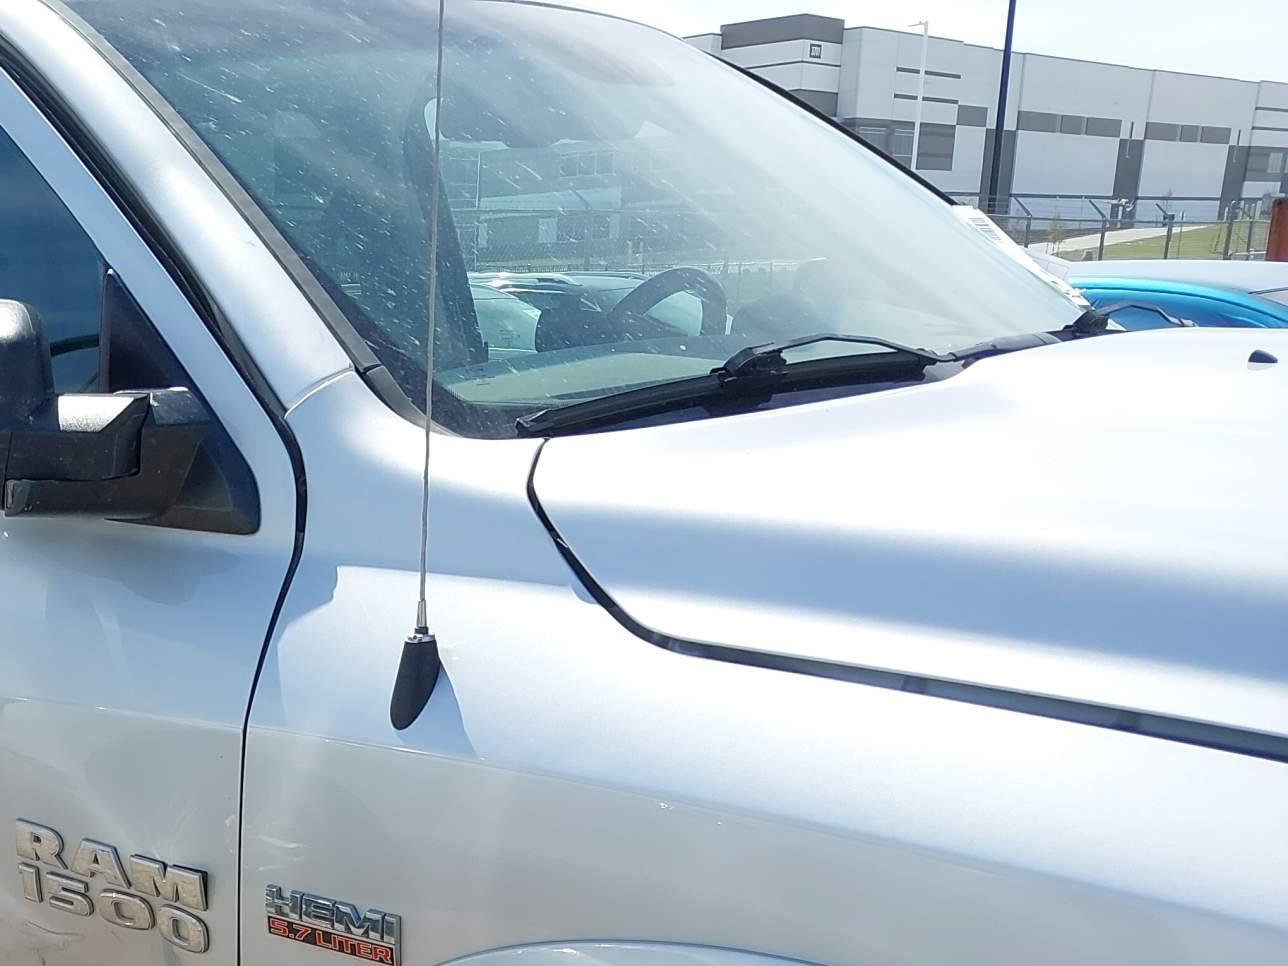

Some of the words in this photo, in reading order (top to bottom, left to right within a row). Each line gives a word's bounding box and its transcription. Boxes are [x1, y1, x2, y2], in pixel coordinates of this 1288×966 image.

[15, 817, 208, 912] RAM
[18, 862, 210, 954] 1500
[265, 884, 401, 944] HEMI
[269, 917, 312, 942] 5.7
[314, 929, 394, 966] LITER
